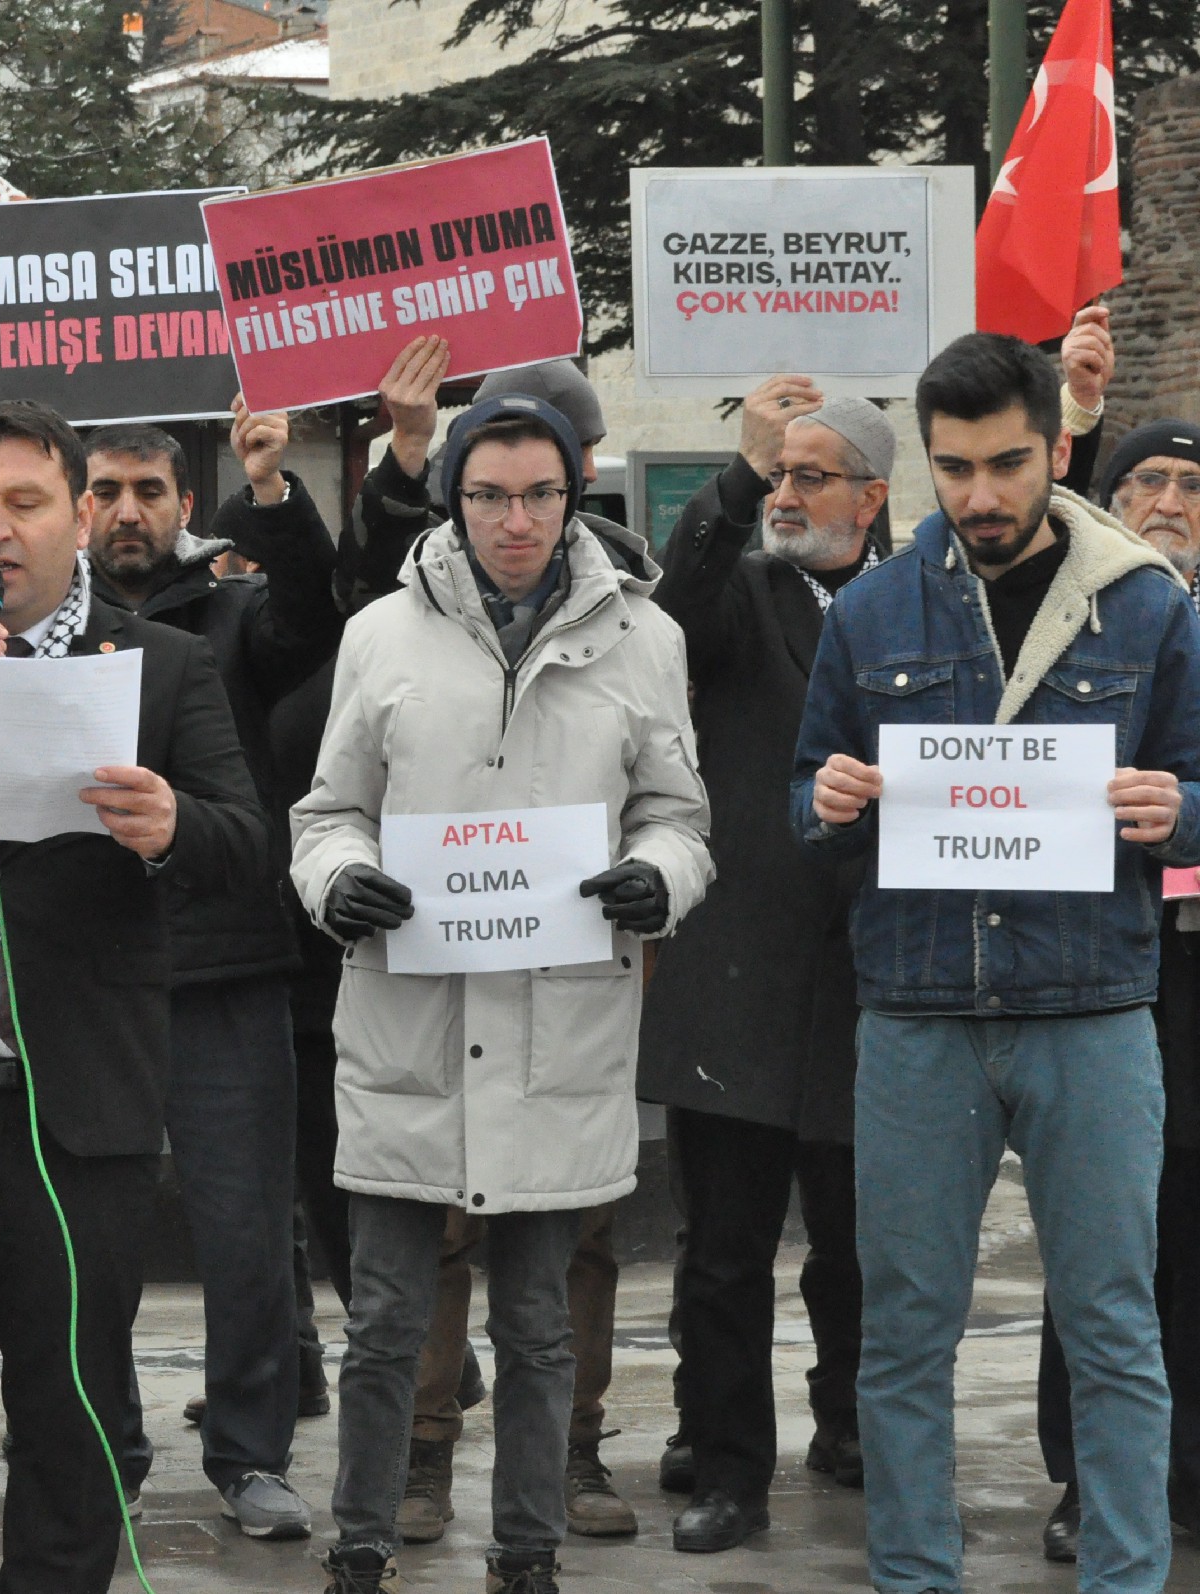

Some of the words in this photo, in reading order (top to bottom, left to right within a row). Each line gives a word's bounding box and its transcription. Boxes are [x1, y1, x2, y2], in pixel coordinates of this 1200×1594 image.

[225, 228, 424, 302] MÜSLÜMAN
[429, 202, 556, 263] UYUMA
[662, 232, 775, 258] GAZZE,
[783, 231, 911, 257] BEYRUT,
[673, 261, 783, 288] KIBRIS,
[790, 260, 901, 284] HATAY..
[235, 290, 388, 355] FİLİSTİNE
[392, 265, 496, 326] SAHİP
[503, 257, 566, 312] ÇIK
[676, 290, 748, 321] ÇOK
[752, 290, 899, 313] YAKINDA!
[919, 736, 1014, 761] DON'T
[1022, 737, 1057, 762] BE
[950, 785, 1027, 809] FOOL
[442, 821, 529, 847] APTAL
[933, 835, 1041, 861] TRUMP
[446, 868, 530, 894] OLMA
[438, 916, 541, 942] TRUMP
